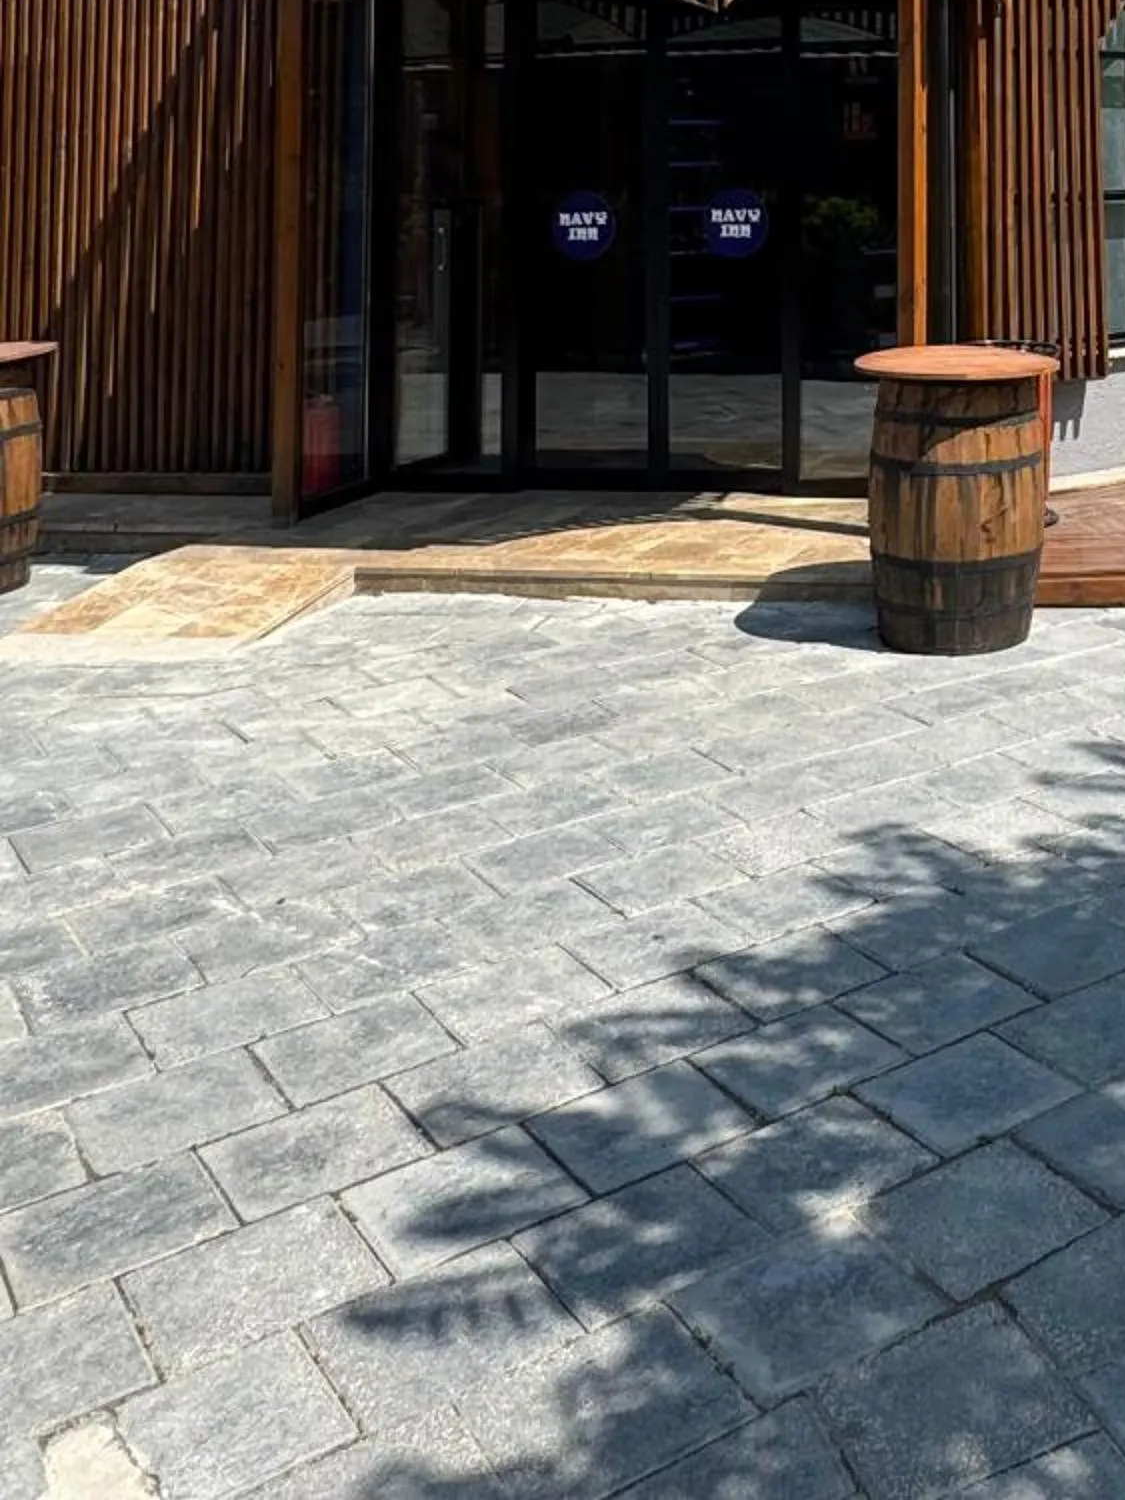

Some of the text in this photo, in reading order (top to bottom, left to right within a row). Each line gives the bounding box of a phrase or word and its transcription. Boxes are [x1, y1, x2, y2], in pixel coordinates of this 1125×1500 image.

[559, 211, 608, 226] NAVY
[710, 208, 761, 223] NAVY
[567, 227, 599, 241] INN
[719, 223, 752, 238] INN
